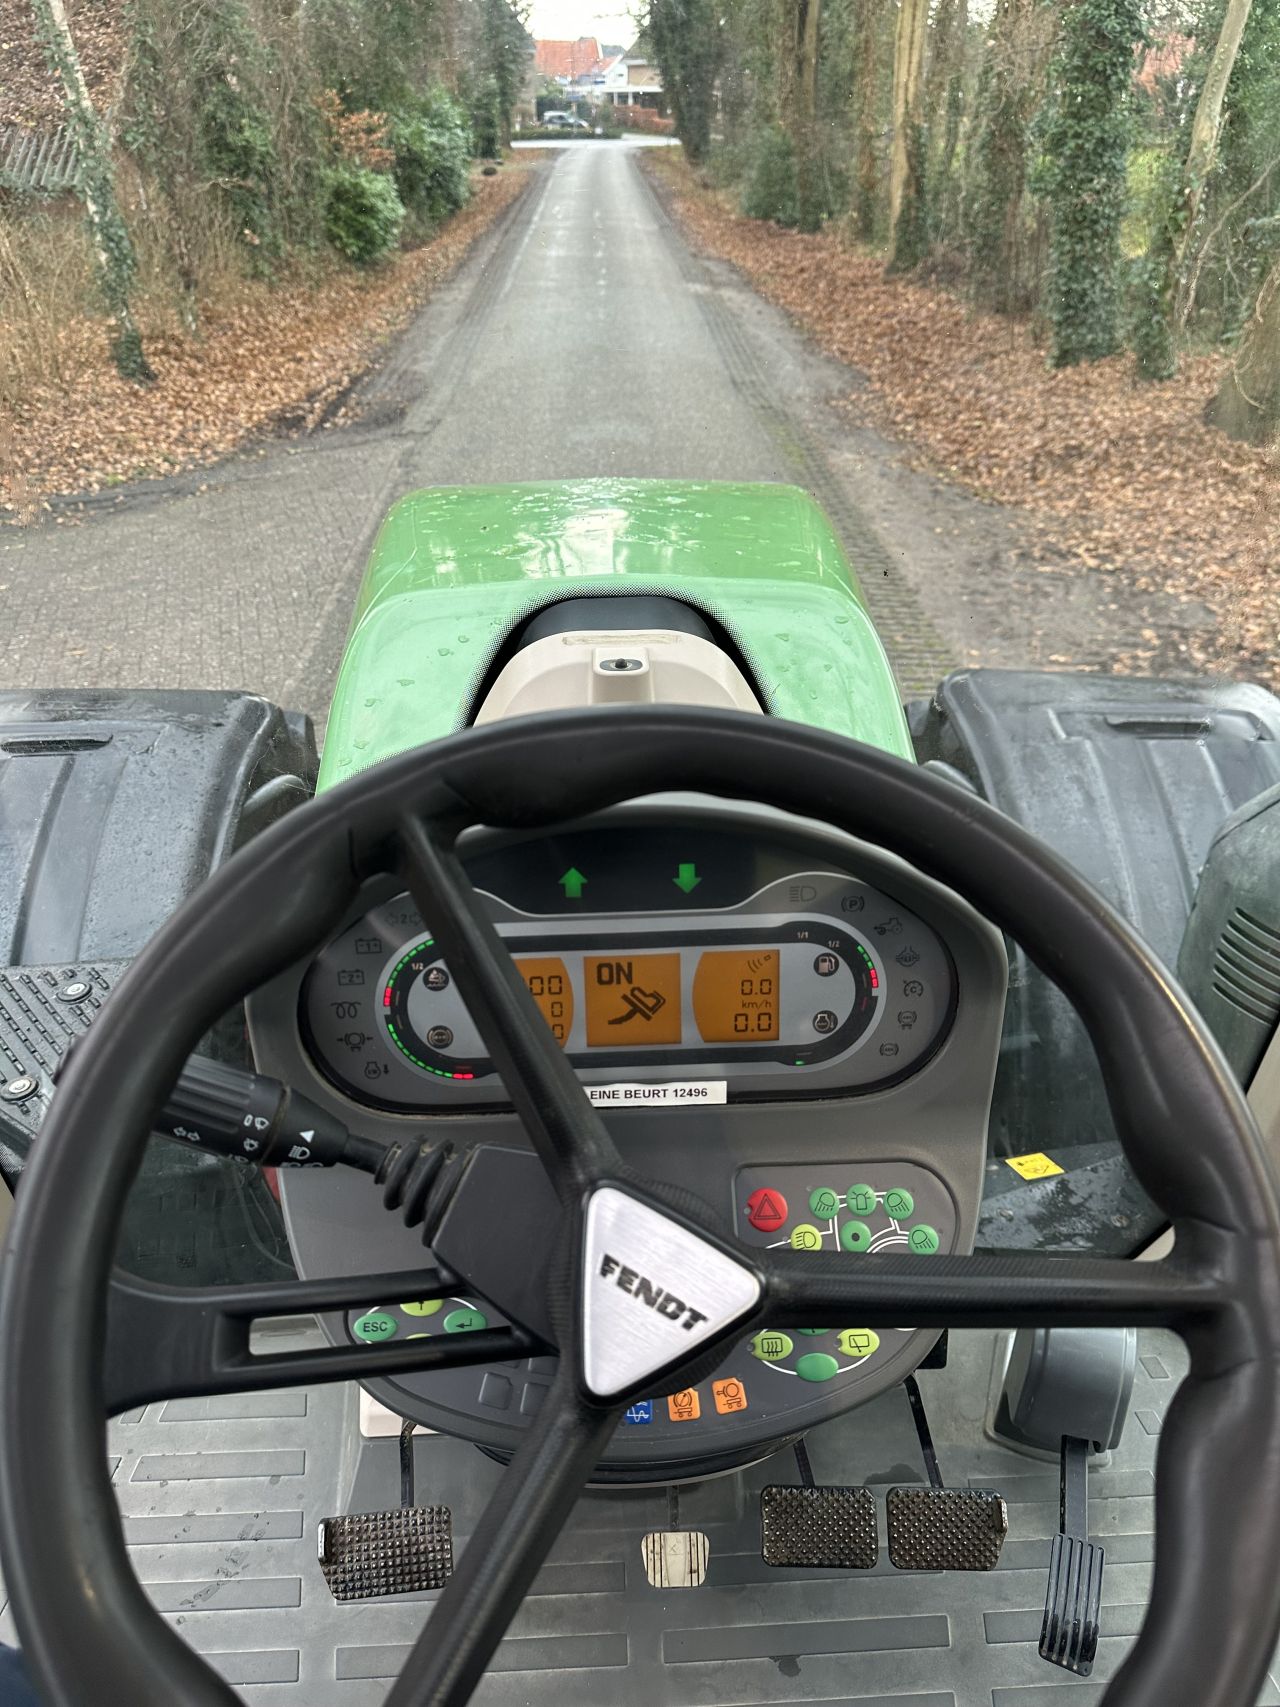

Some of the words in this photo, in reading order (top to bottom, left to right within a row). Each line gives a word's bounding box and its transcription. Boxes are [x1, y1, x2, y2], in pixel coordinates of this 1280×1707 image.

[797, 931, 809, 939] 1/1
[828, 940, 840, 948] 1/2
[411, 962, 424, 970] 1/2
[596, 962, 633, 986] ON
[526, 975, 562, 995] 00
[741, 979, 772, 995] 0.0
[741, 999, 772, 1009] km/h
[734, 1012, 772, 1032] 0.0
[590, 1090, 620, 1100] EINE
[624, 1088, 669, 1099] BEURT
[672, 1087, 708, 1098] 12496
[599, 1253, 709, 1332] FENDT
[363, 1321, 388, 1333] ESC
